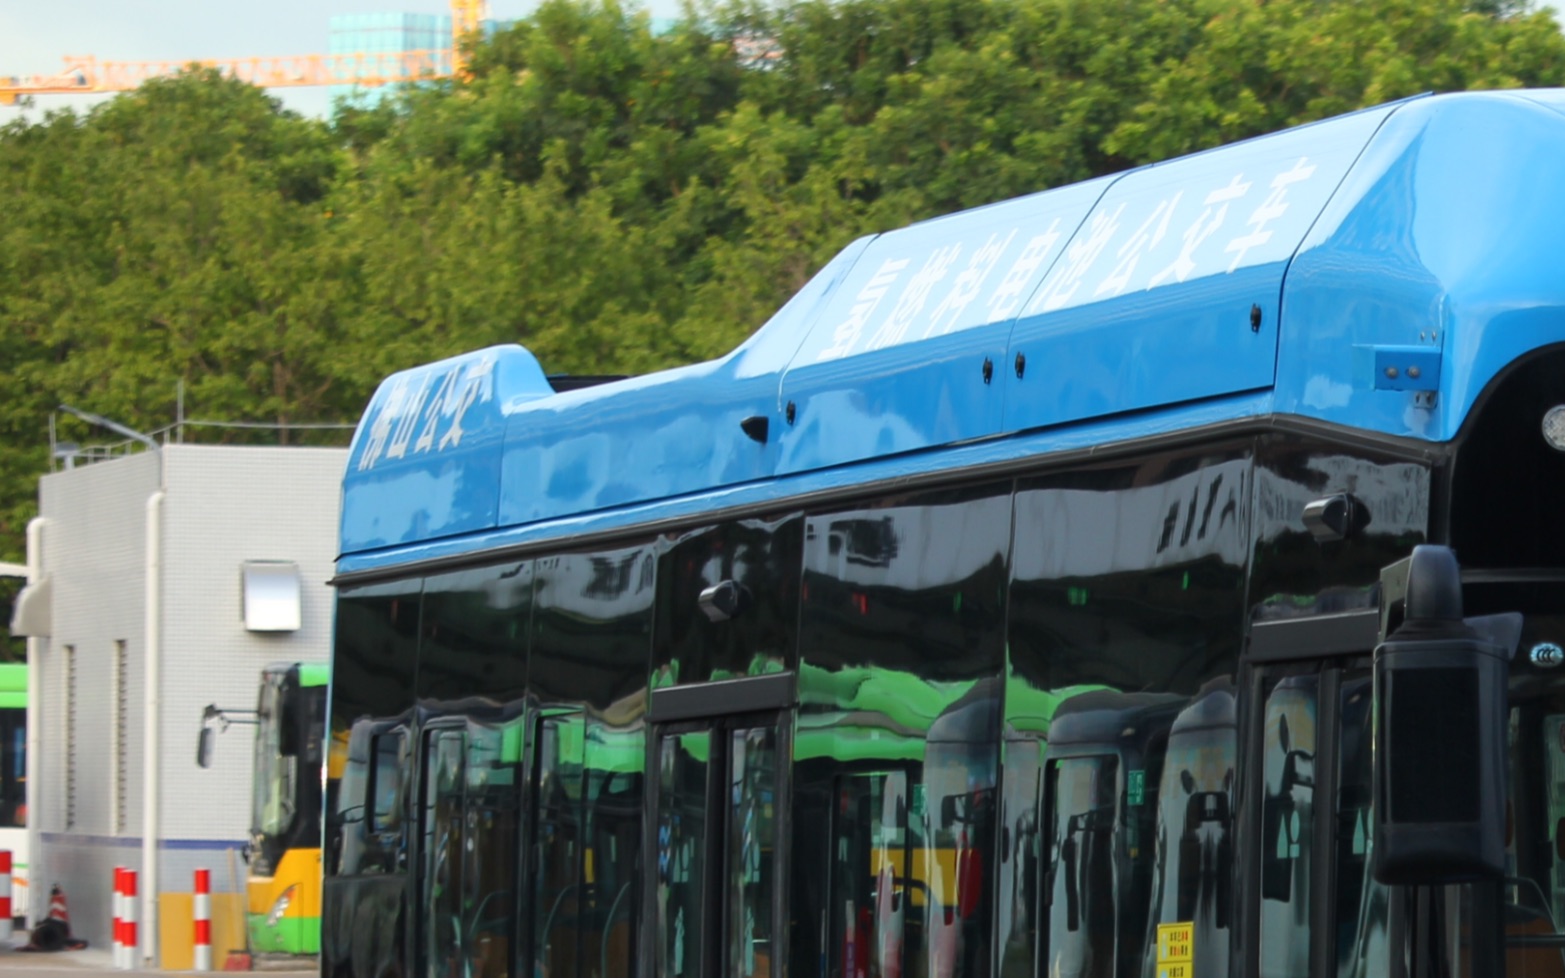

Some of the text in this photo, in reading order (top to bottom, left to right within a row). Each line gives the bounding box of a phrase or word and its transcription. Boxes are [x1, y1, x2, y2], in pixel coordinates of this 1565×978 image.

[816, 156, 1316, 363] 氢燃料电池公交车
[358, 355, 493, 472] 佛山公交
